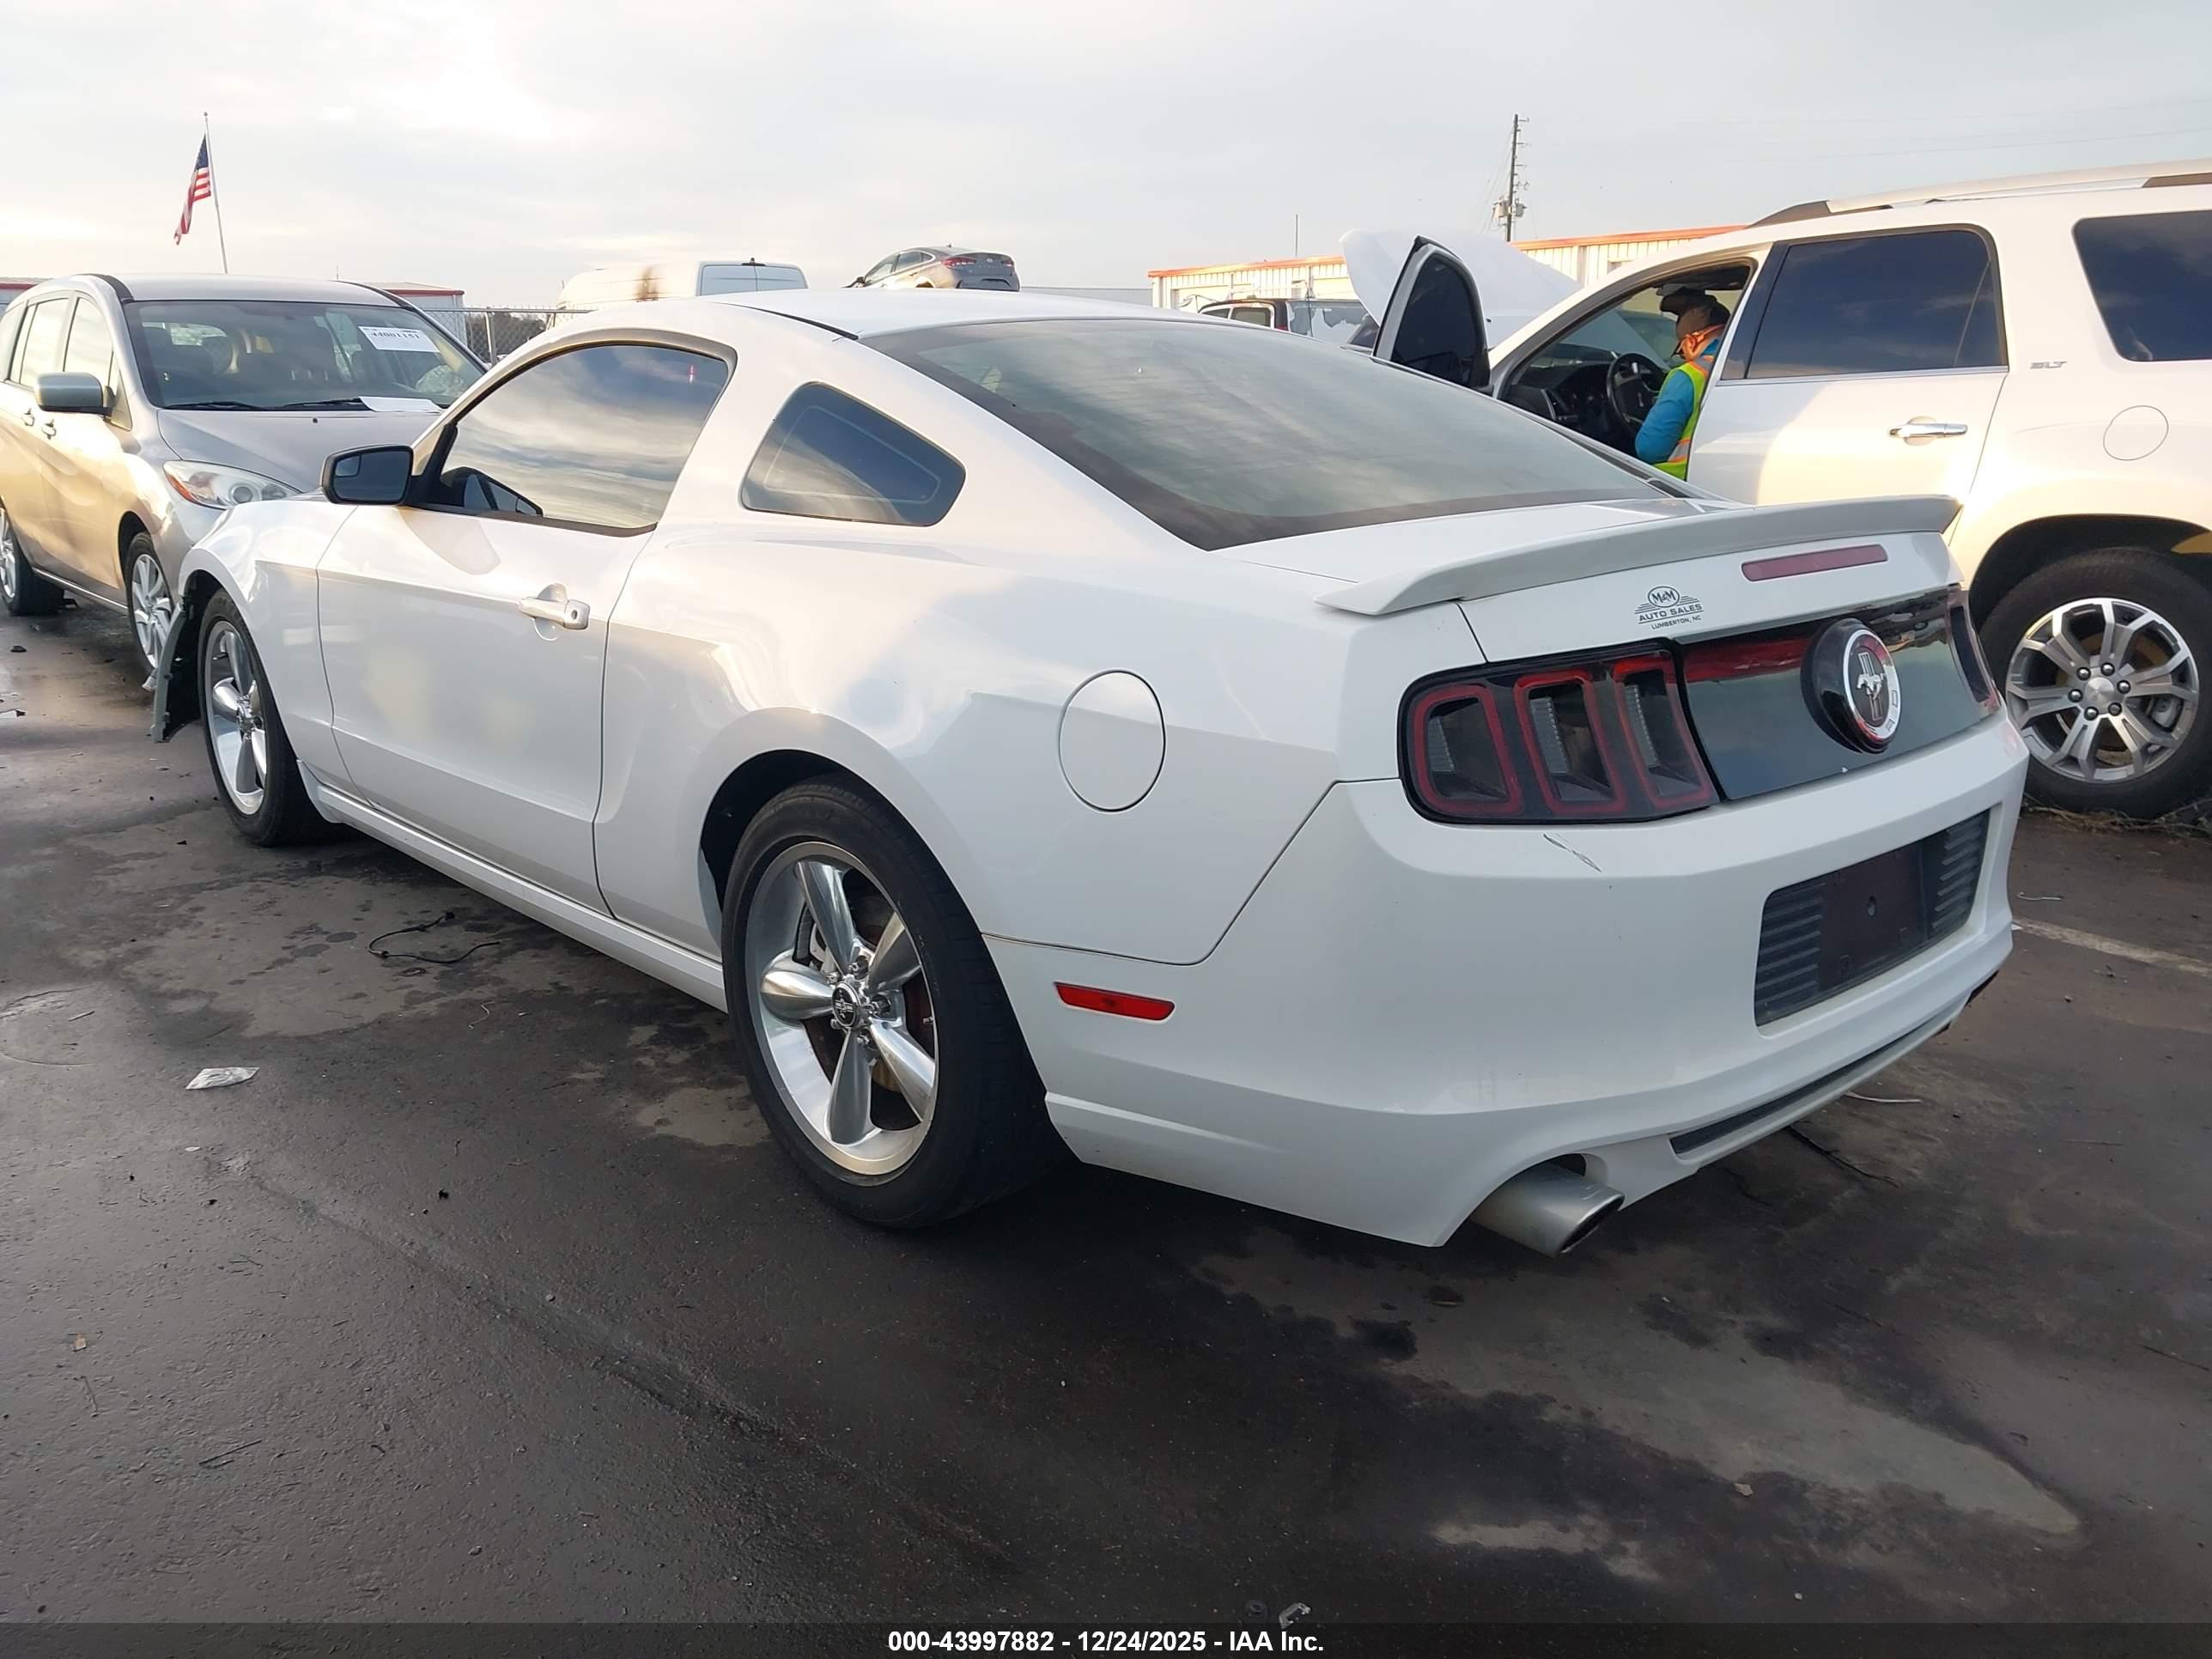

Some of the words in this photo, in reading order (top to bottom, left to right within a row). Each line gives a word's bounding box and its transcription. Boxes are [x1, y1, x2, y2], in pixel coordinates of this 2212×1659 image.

[2030, 361, 2068, 369] SLT
[1650, 590, 1676, 604] M&M
[1639, 611, 1668, 621] AUTO
[1669, 604, 1703, 615] SALES
[1651, 617, 1692, 629] LUMBERTON,
